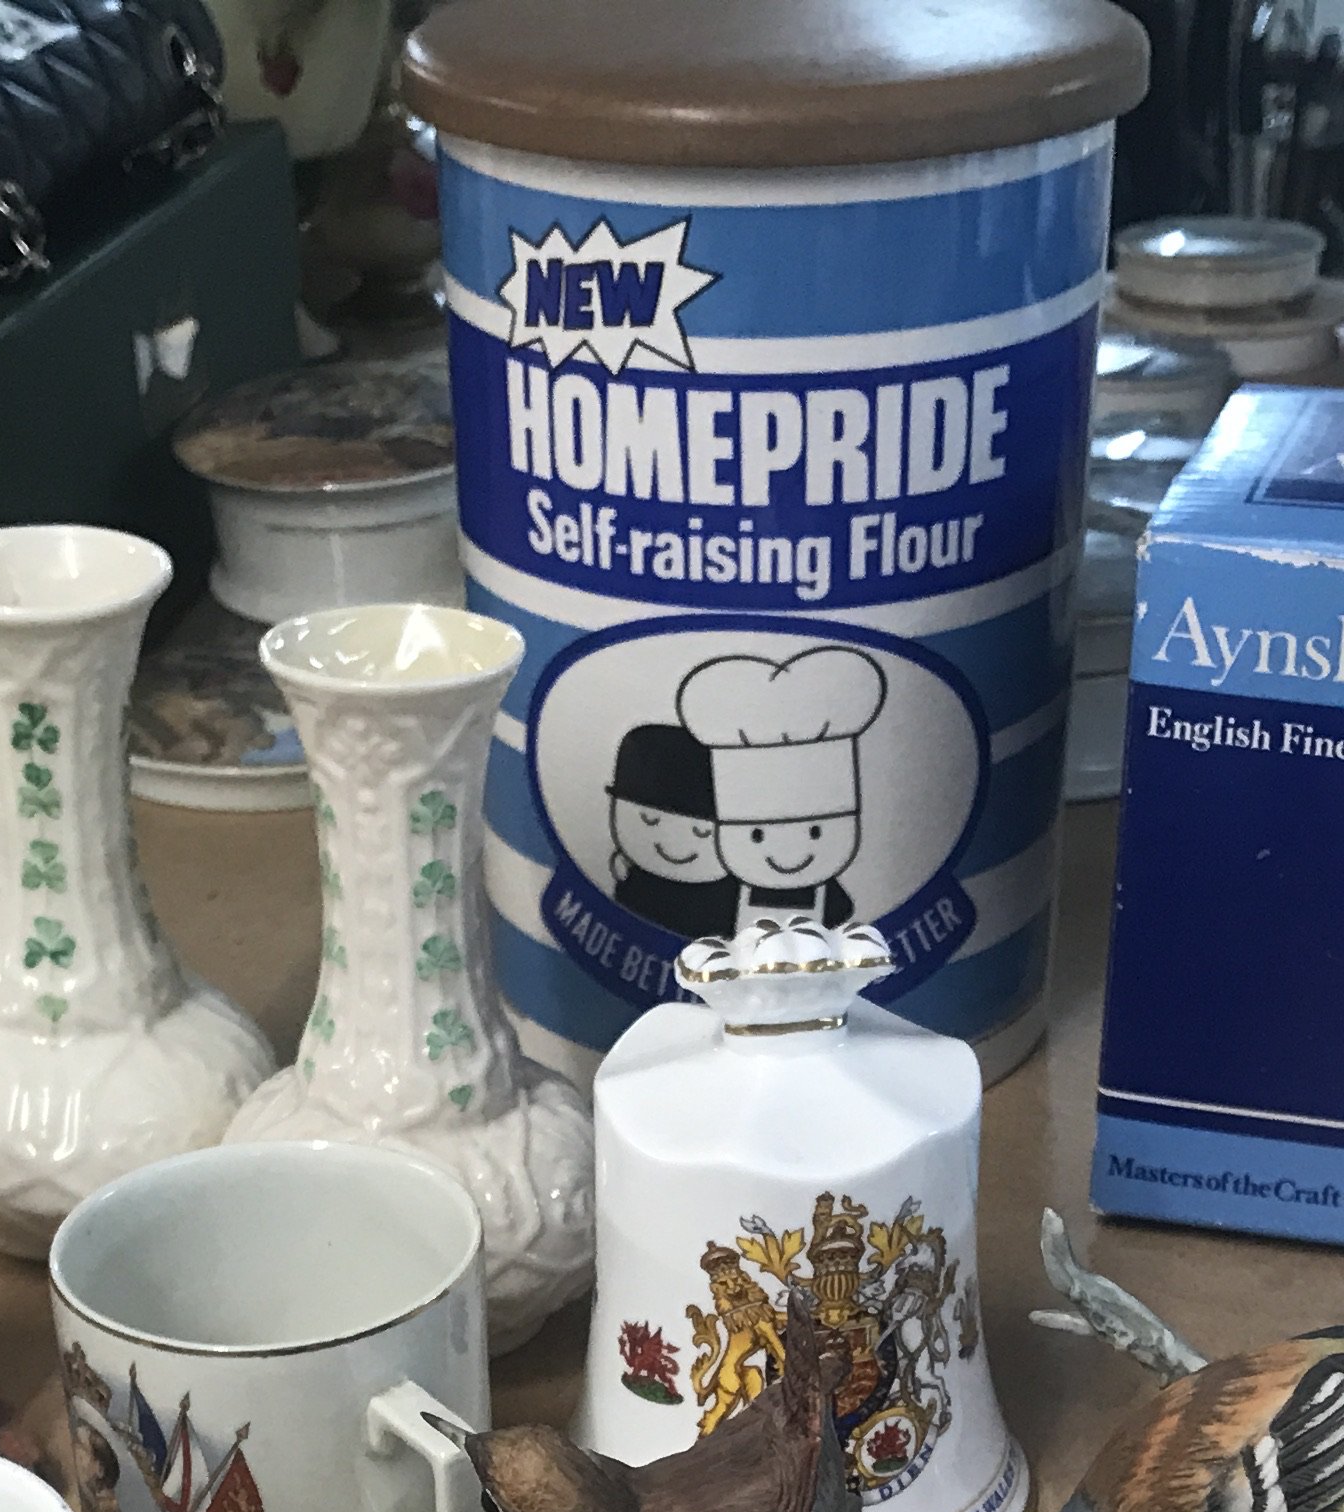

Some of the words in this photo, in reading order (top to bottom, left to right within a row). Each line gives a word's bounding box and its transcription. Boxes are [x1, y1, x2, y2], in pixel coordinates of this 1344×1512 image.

[523, 256, 666, 332] NEW
[504, 358, 1012, 509] HOMEPRIDE
[525, 489, 834, 601] Self-raising
[849, 510, 986, 581] Flour
[1147, 706, 1271, 754] English
[555, 891, 626, 968] MADE
[1108, 1154, 1204, 1189] Masters
[1206, 1171, 1231, 1192] of
[1232, 1173, 1271, 1199] the
[1274, 1177, 1342, 1206] Craft
